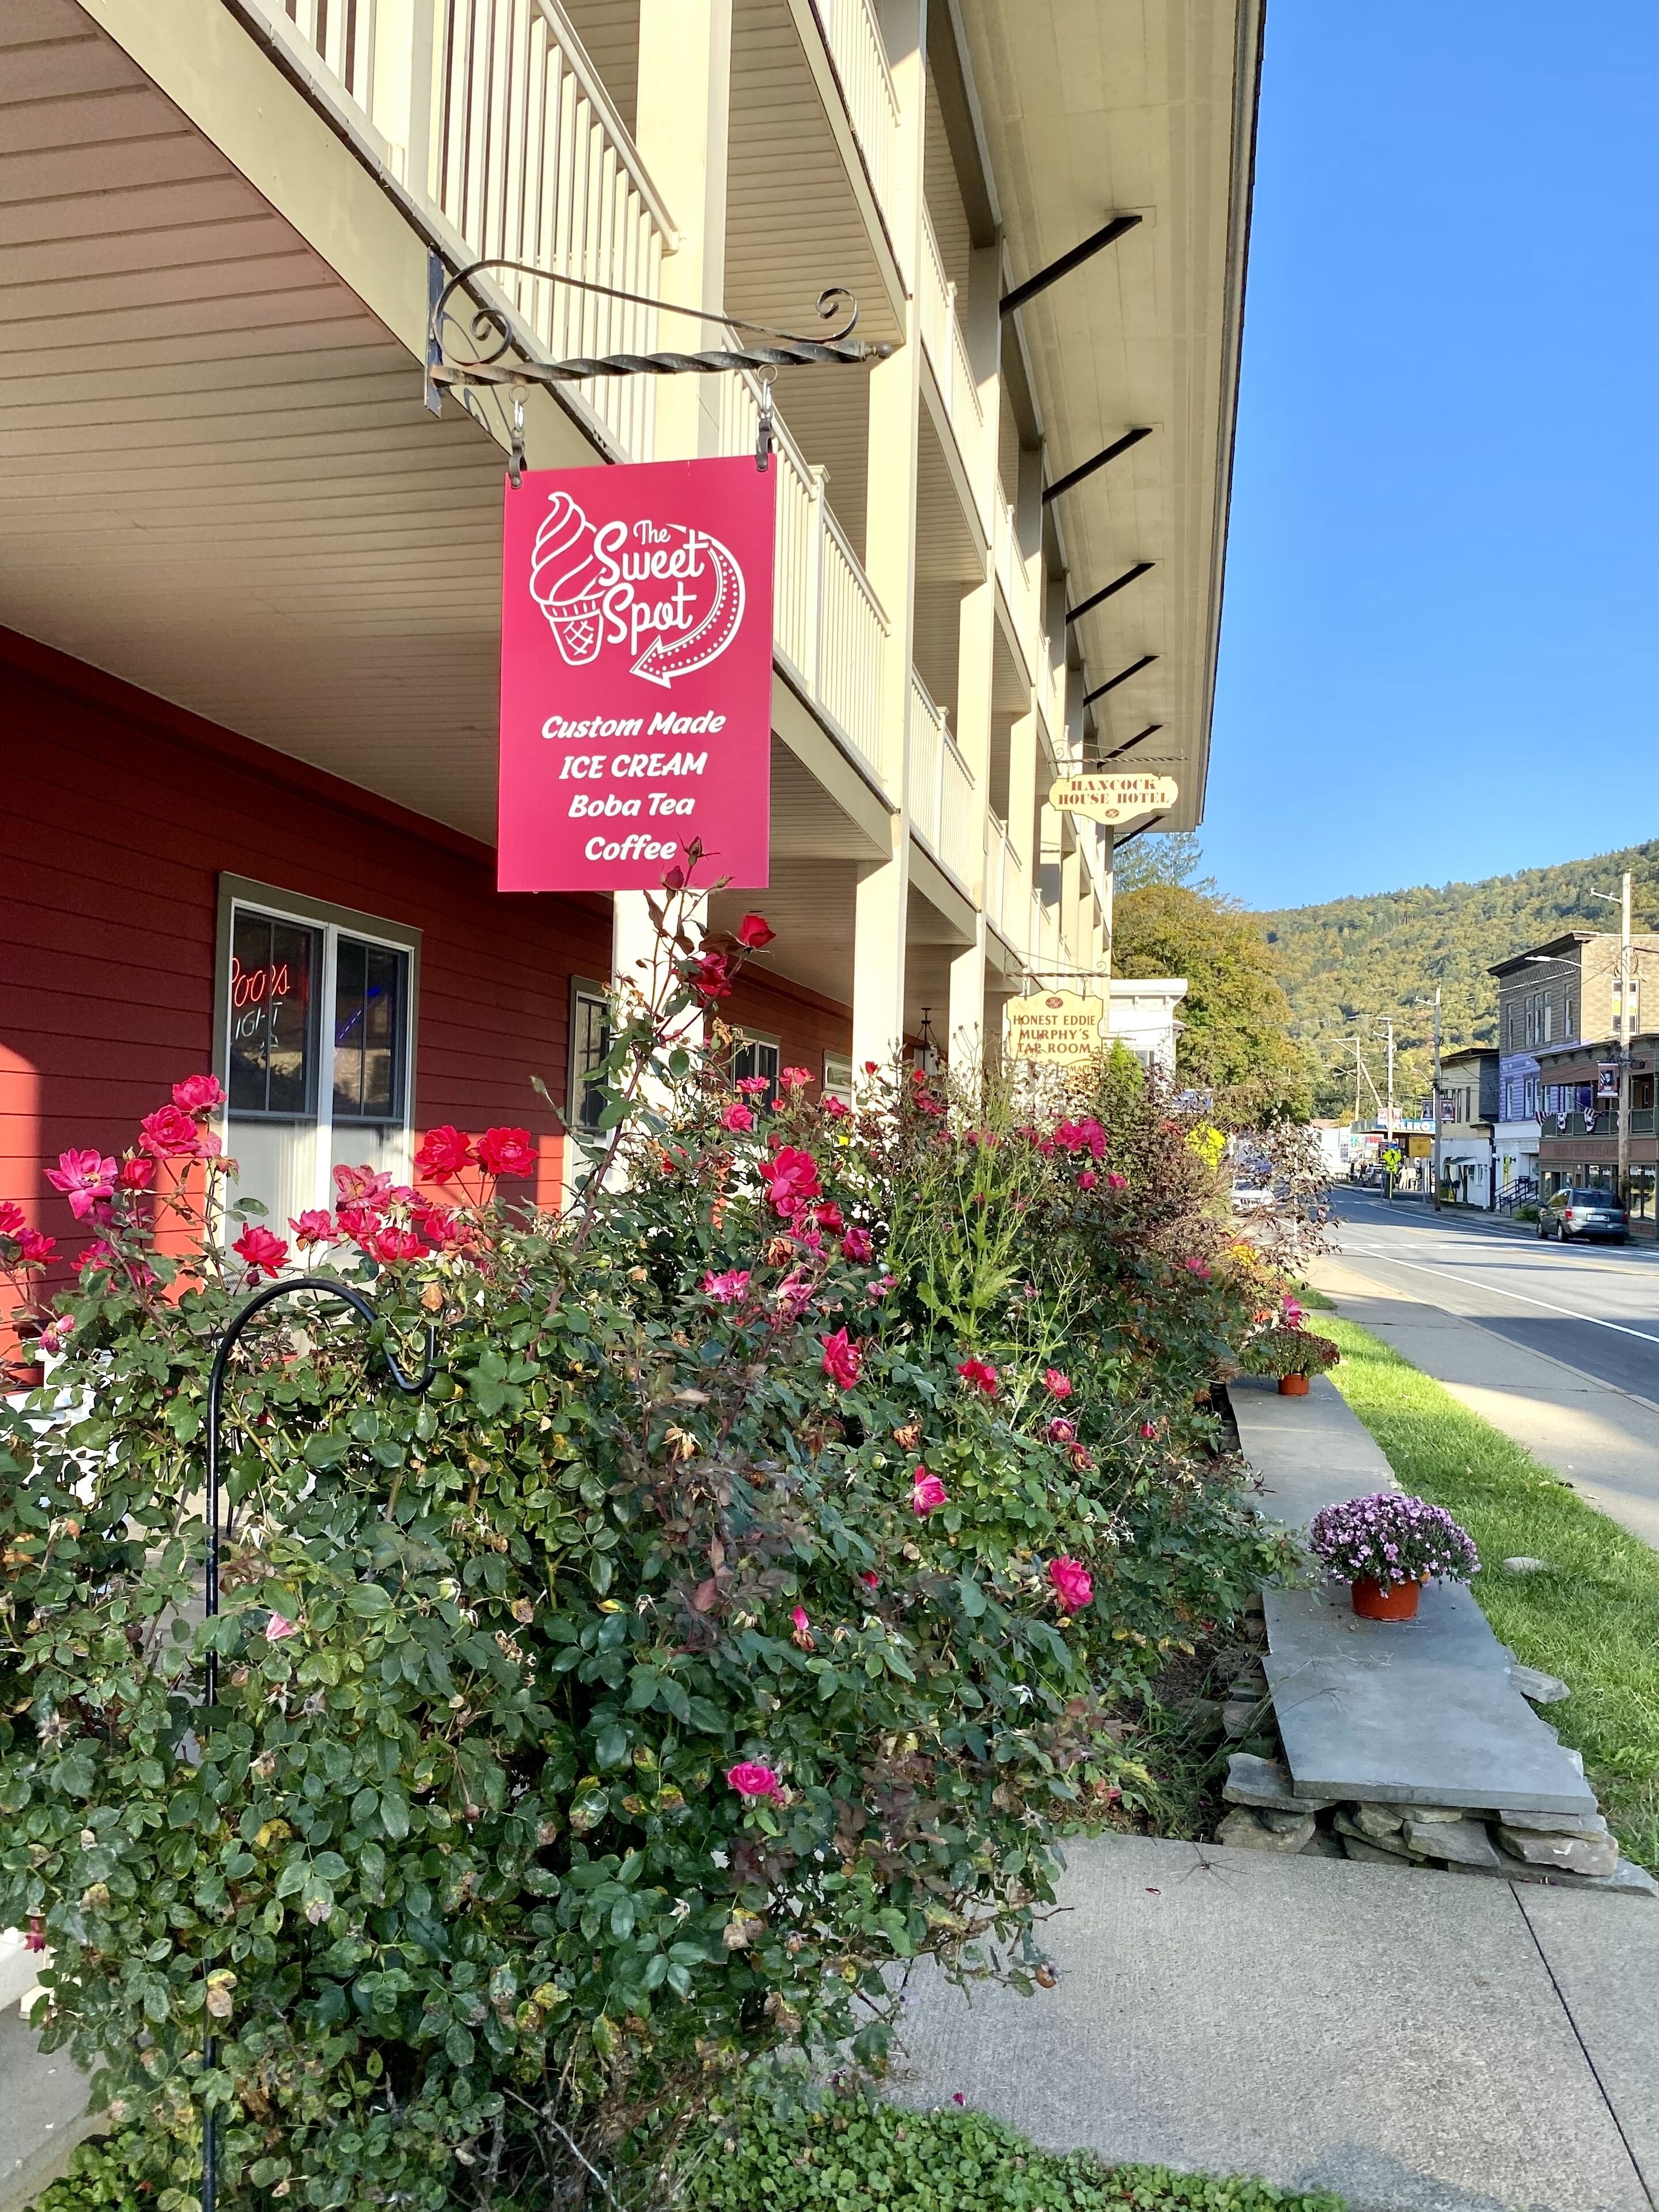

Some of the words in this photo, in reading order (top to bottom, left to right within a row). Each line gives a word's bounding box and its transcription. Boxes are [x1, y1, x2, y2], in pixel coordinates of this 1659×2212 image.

[634, 520, 671, 546] The
[593, 521, 709, 586] Sweet
[603, 581, 698, 656] Spot
[541, 715, 643, 739] Custom
[647, 710, 726, 736] Made
[559, 755, 607, 779] ICE
[611, 752, 708, 778] CREAM
[1070, 779, 1157, 791] HANCOCK
[567, 793, 641, 818] Boba
[647, 793, 695, 816] Tea
[1058, 793, 1109, 805] HOUSE
[1117, 792, 1170, 804] HOTEL
[585, 834, 677, 861] Coffee
[234, 1001, 283, 1040] IGHT
[1013, 1015, 1058, 1025] HONEST
[1063, 1015, 1096, 1025] EDDIE
[1020, 1028, 1089, 1040] MURPHY'S
[1048, 1043, 1091, 1054] ROOM
